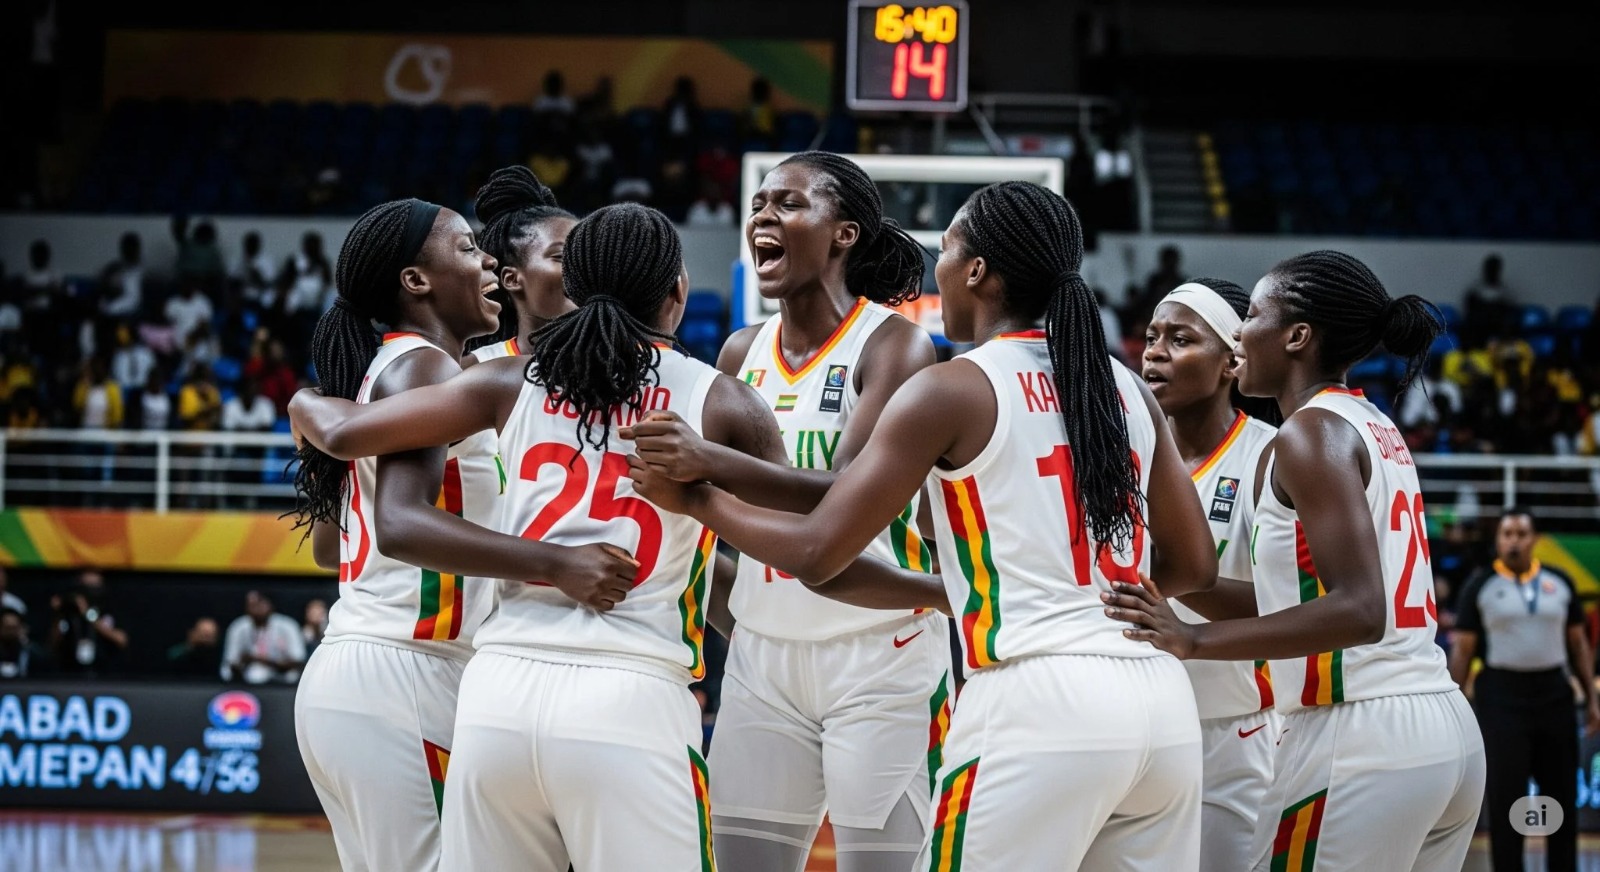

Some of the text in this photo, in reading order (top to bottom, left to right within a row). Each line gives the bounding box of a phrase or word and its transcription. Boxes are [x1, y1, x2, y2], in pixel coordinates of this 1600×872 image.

[891, 41, 947, 100] 14
[519, 442, 663, 588] 25
[0, 694, 131, 742] ABAD
[0, 742, 167, 791] MEPAN
